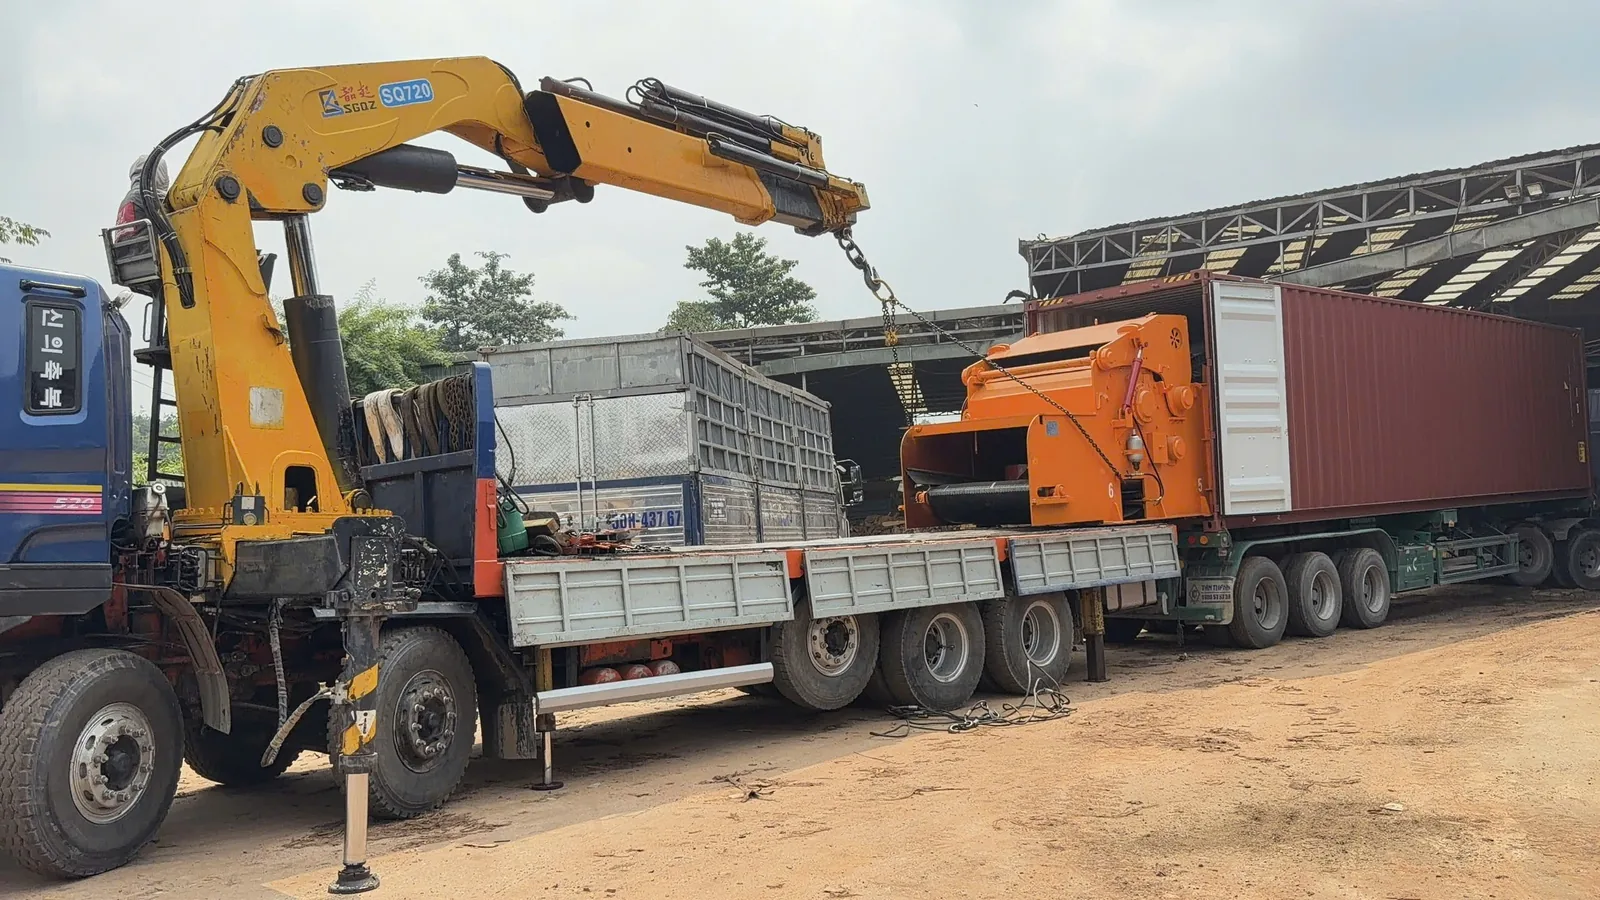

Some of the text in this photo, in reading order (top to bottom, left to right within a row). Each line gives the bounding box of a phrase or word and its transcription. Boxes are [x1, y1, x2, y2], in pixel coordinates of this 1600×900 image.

[381, 83, 431, 104] SQ720
[344, 101, 377, 114] SGQZ
[1108, 482, 1114, 499] 6
